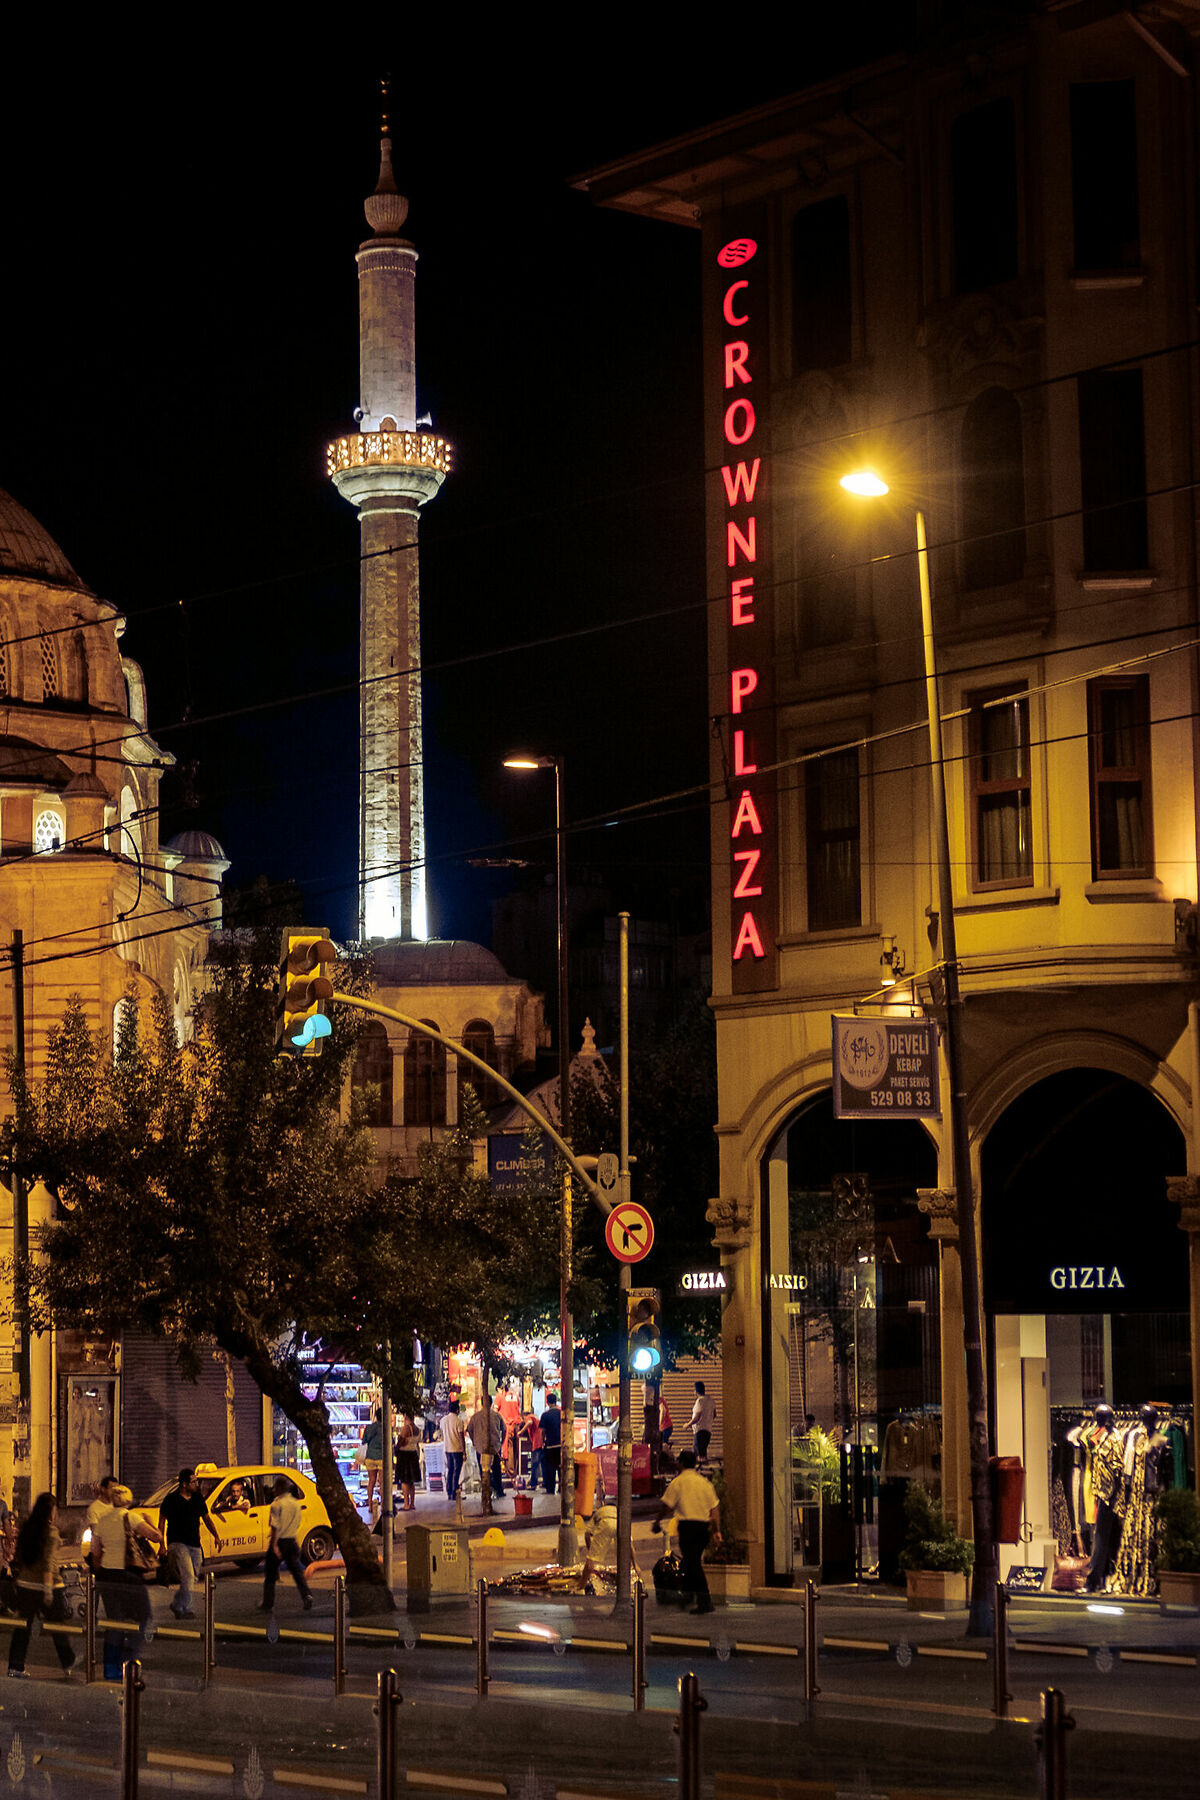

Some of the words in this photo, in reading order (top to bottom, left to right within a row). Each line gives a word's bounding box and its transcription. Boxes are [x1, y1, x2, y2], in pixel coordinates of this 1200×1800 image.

[721, 279, 761, 627] CROWNE
[731, 668, 765, 960] PLAZA
[896, 1058, 921, 1072] KEBAP
[890, 1077, 907, 1087] PAKET
[871, 1091, 893, 1106] 529
[897, 1091, 912, 1106] 08
[916, 1091, 931, 1106] 33
[681, 1271, 727, 1289] GIZIA
[1050, 1266, 1125, 1289] GIZIA
[232, 1537, 246, 1546] TBL
